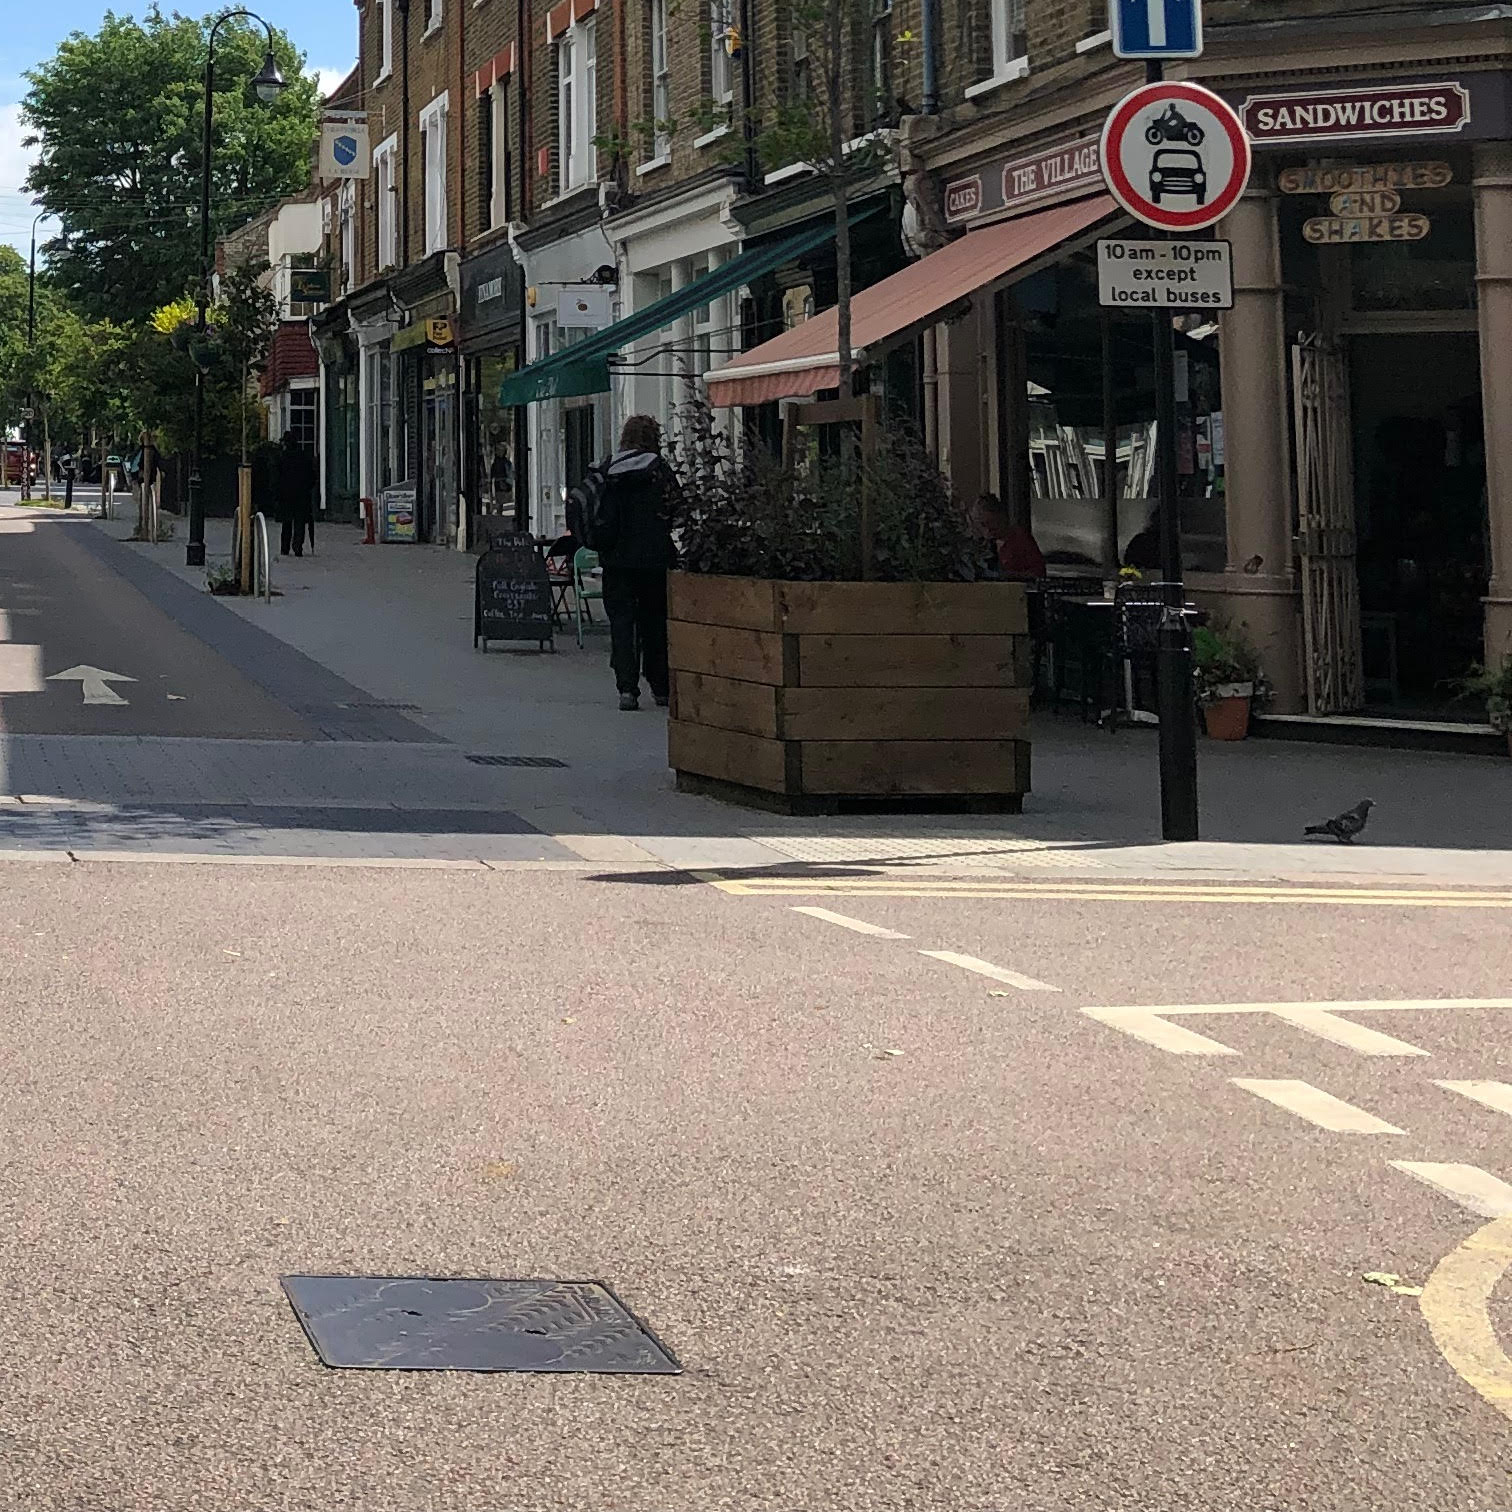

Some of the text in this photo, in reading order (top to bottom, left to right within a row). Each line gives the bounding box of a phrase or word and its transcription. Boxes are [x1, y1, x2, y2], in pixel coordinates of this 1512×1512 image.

[1257, 96, 1448, 131] SANDWICHES
[949, 144, 1098, 211] CAKES THE VILLAGE
[1339, 193, 1397, 215] AND
[1307, 216, 1424, 242] SHAKES
[1133, 267, 1197, 283] except
[1111, 286, 1222, 303] local buses
